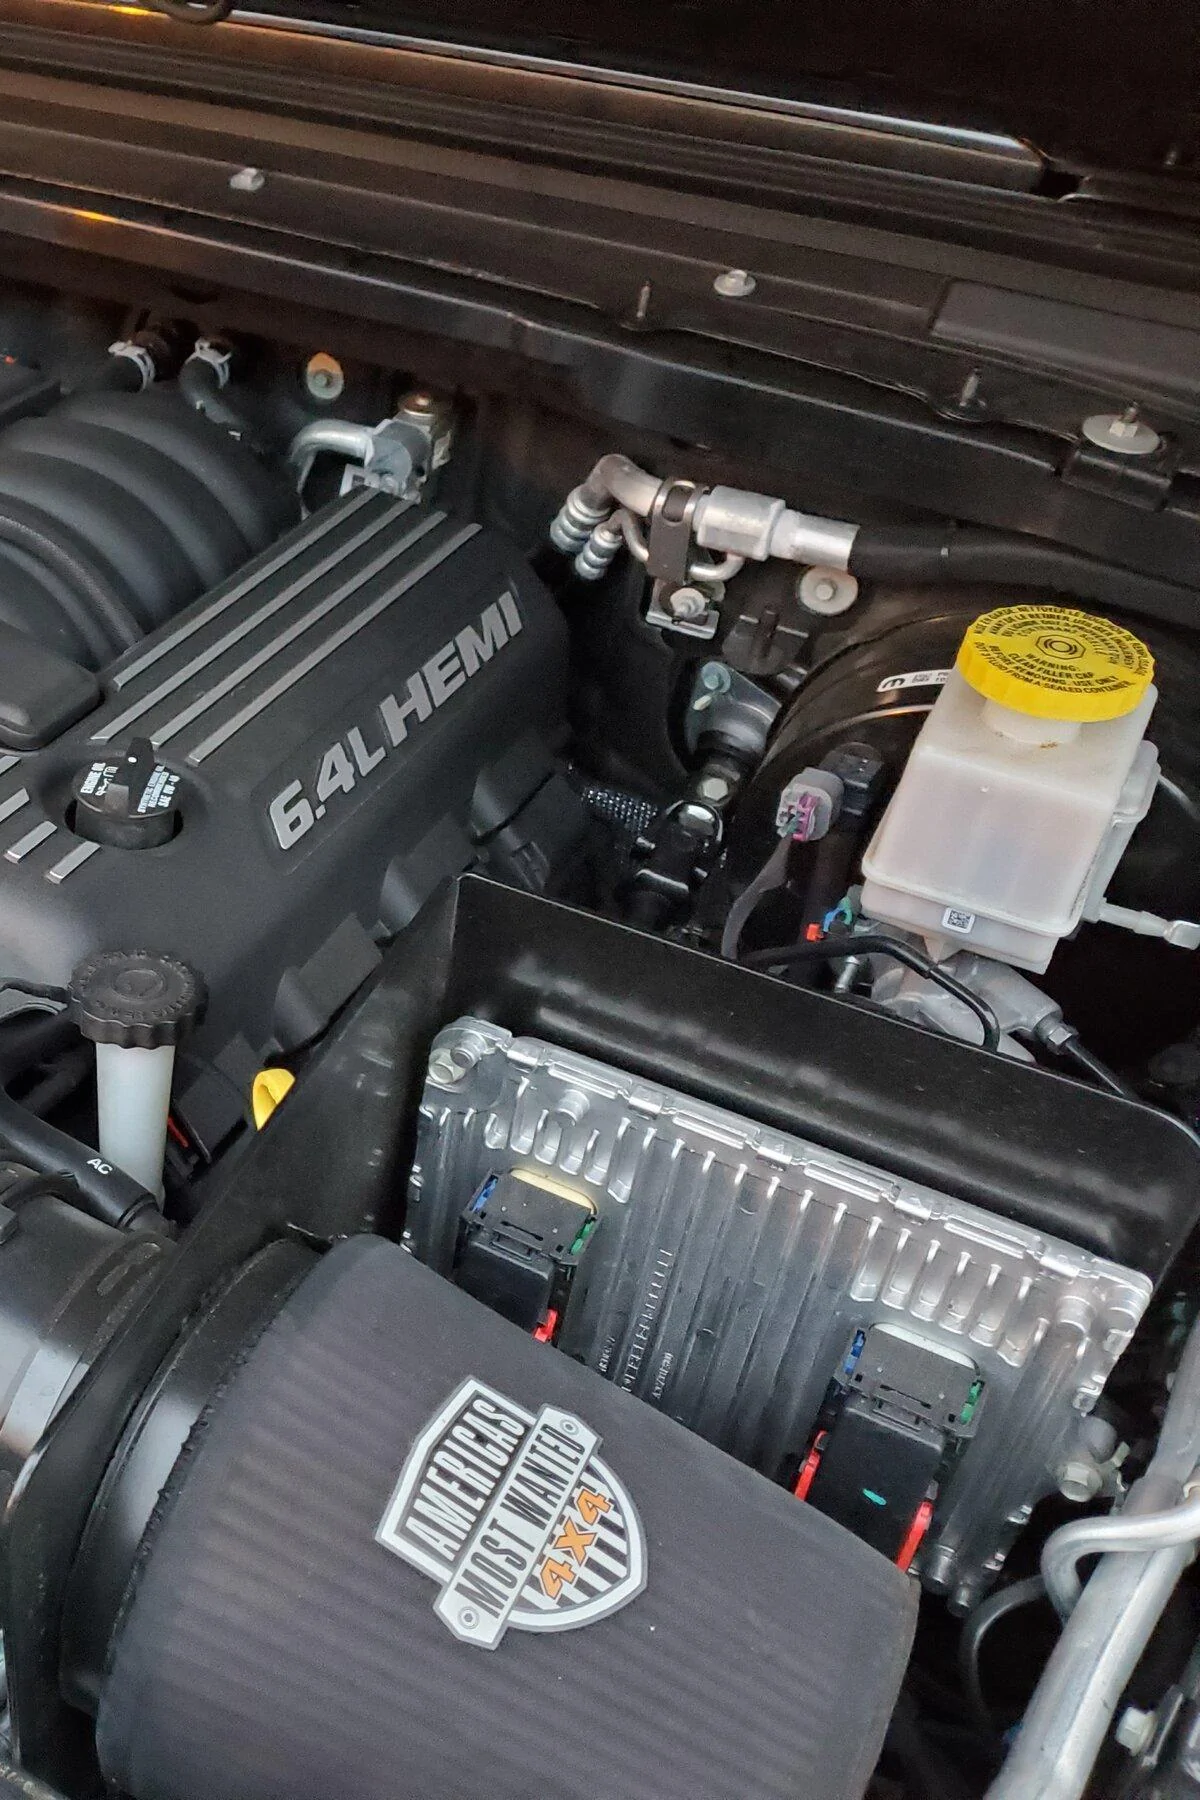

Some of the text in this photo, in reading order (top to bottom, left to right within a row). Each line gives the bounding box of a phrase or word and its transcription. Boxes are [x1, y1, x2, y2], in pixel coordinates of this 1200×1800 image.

[973, 641, 990, 653] DOT
[984, 656, 1010, 671] FLUID
[1004, 669, 1035, 683] FROM
[1042, 681, 1083, 693] SEALED
[986, 645, 1016, 665] BEFORE
[1093, 674, 1120, 684] ONLY
[1006, 653, 1038, 669] CLEAN
[1035, 666, 1072, 678] FILLER
[1022, 653, 1082, 671] WARNING:
[269, 591, 523, 849] 6.4L HEMI
[80, 762, 106, 794] ENGINE OIL
[158, 794, 172, 807] SAE
[86, 1158, 113, 1175] AC
[405, 1399, 525, 1561] AMERICAS
[454, 1424, 585, 1619] MOST WANTED
[540, 1488, 612, 1599] 4X4
